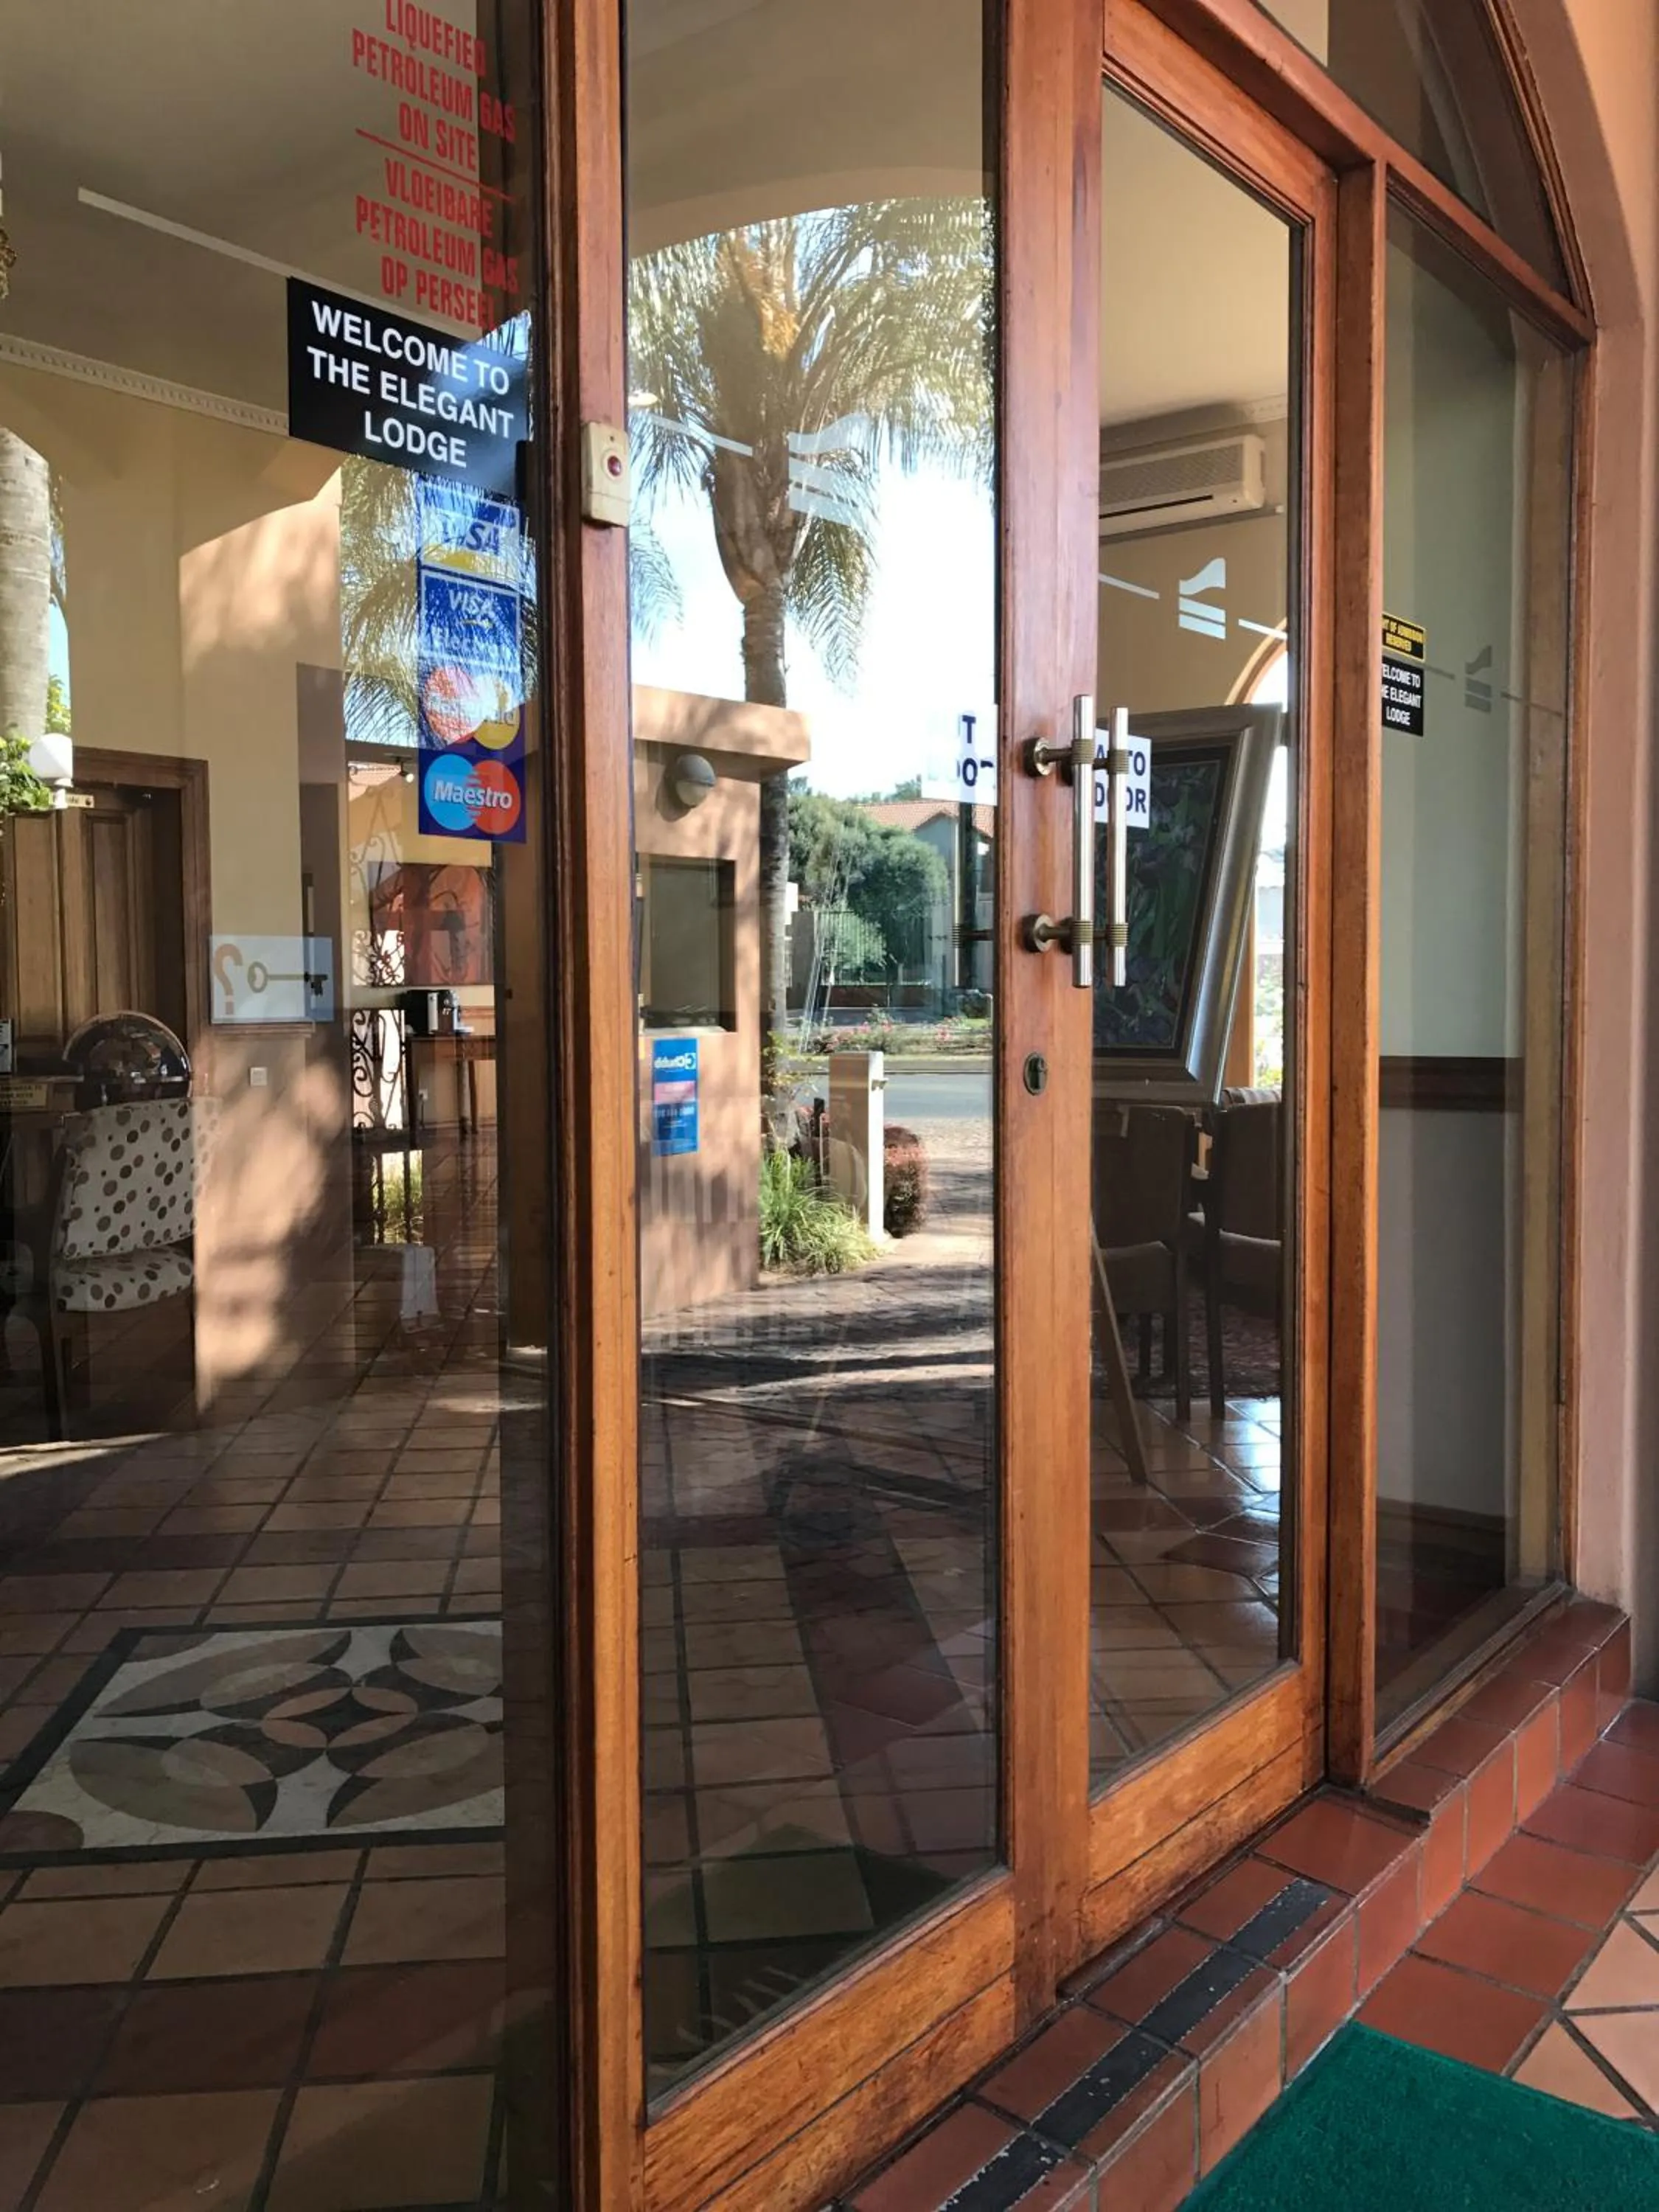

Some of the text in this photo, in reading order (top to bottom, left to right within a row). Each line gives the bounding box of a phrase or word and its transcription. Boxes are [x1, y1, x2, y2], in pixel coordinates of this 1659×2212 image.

[386, 0, 487, 77] LIQUEFIED
[352, 27, 515, 143] PETROLEUM GAS
[398, 102, 477, 172] ON SITE
[385, 157, 494, 238] VLOEIBARE
[355, 195, 519, 294] PETROLEUM GAS
[381, 256, 495, 331] OP PERSEEL
[311, 300, 509, 395] WELCOME TO
[307, 346, 514, 439] THE ELEGANT
[365, 411, 467, 468] LODGE
[1382, 664, 1411, 685] ELCOME
[1386, 706, 1411, 726] LODGE
[434, 779, 512, 810] Maestro
